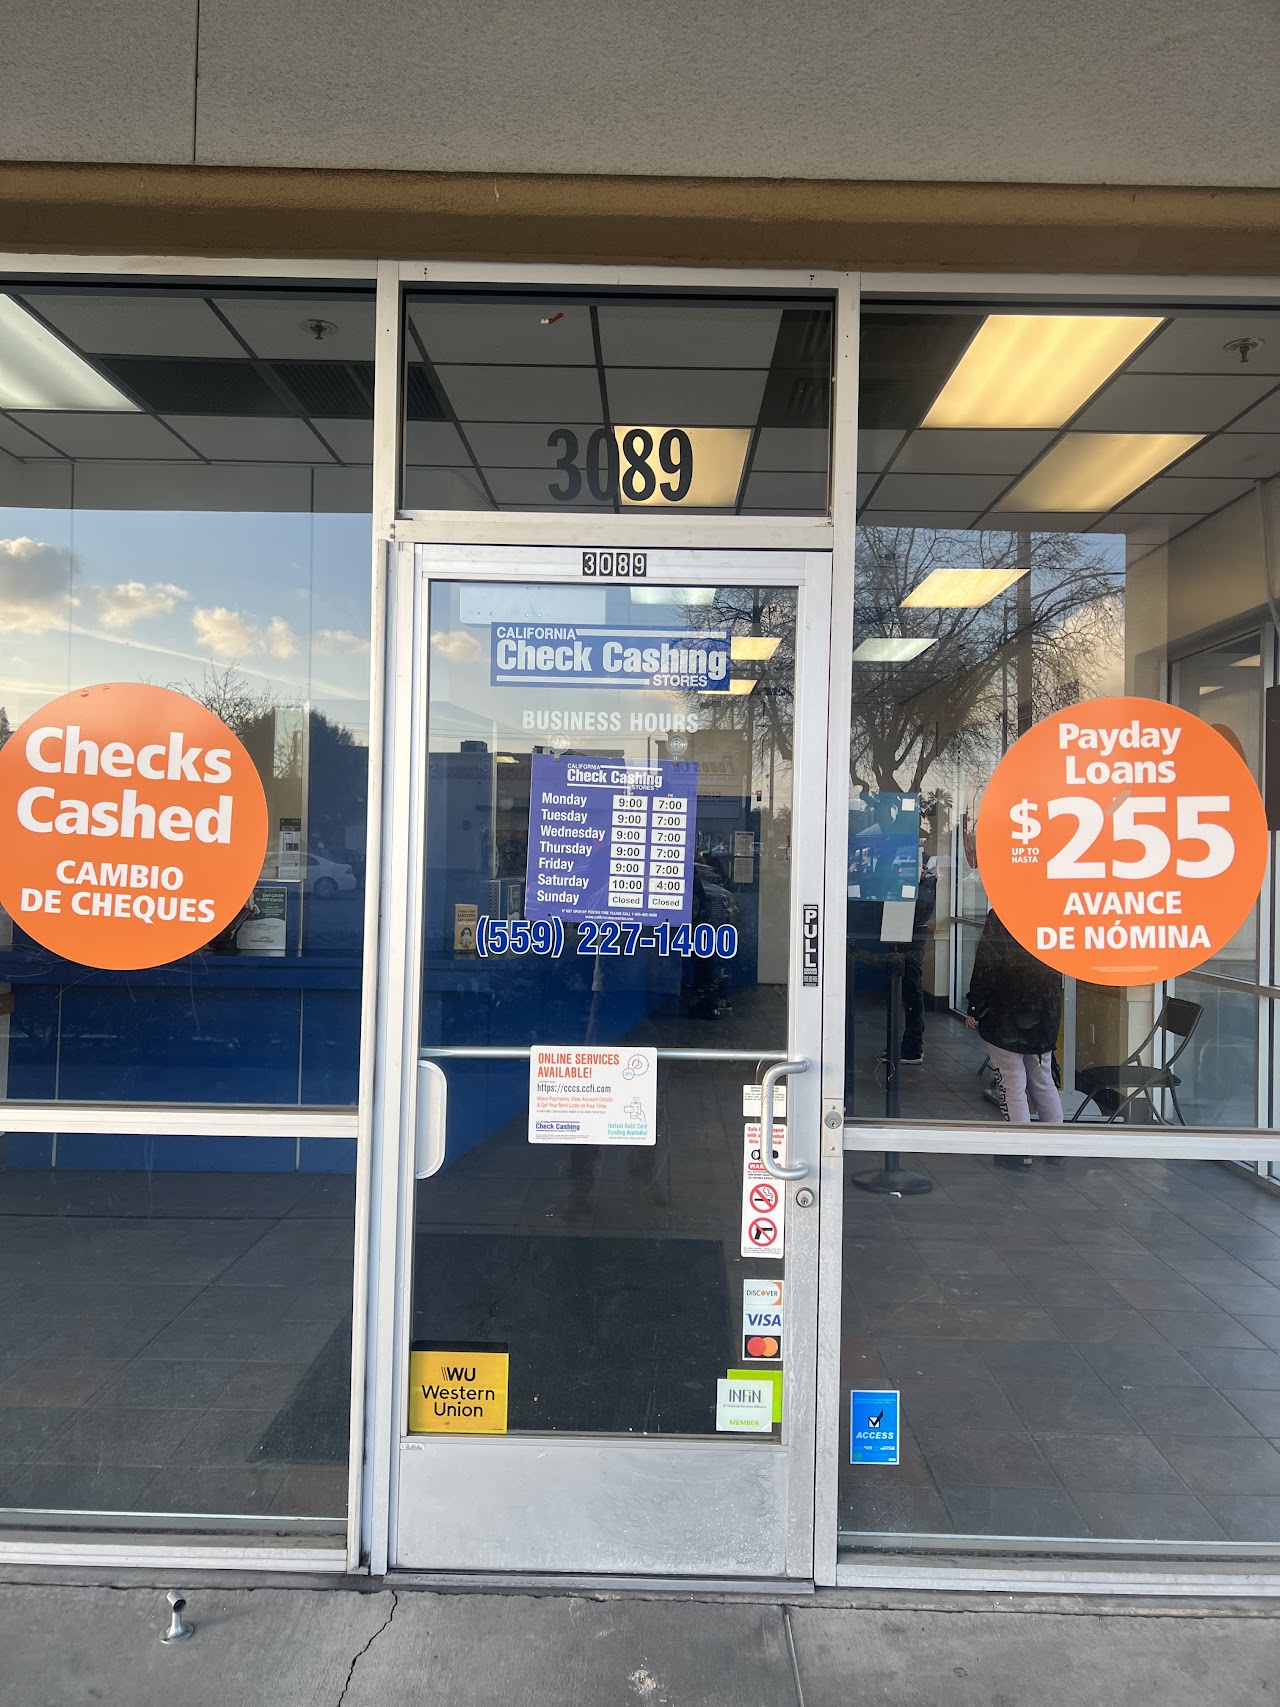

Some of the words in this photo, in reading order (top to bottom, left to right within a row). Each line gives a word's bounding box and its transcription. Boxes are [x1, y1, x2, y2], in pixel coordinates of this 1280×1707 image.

[547, 428, 693, 502] 3089
[583, 552, 646, 576] 3089
[496, 626, 576, 640] CALIFORNIA
[496, 639, 593, 672] Check
[602, 641, 727, 680] Cashing
[652, 674, 708, 687] STORES
[522, 710, 622, 732] BUSINESS
[630, 712, 699, 733] HOURS
[1058, 720, 1182, 756] Payday
[25, 725, 233, 784] Checks
[567, 768, 607, 783] Check
[610, 770, 663, 788] Cashing
[1065, 756, 1176, 785] Loans
[541, 792, 587, 807] Monday
[618, 798, 643, 808] 9:00
[658, 800, 682, 810] 7:00
[17, 786, 234, 844] Cashed
[541, 809, 588, 824] Tuesday
[617, 814, 641, 824] 9:00
[657, 816, 680, 826] 7:00
[540, 825, 605, 841] Wednesday
[616, 830, 640, 840] 9:00
[657, 832, 680, 842] 7:00
[539, 841, 592, 857] Thursday
[616, 847, 640, 857] 9:00
[656, 849, 680, 858] 7:00
[1011, 848, 1025, 856] UP
[1027, 848, 1040, 856] TO
[538, 857, 574, 872] Friday
[615, 863, 639, 873] 9:00
[655, 865, 679, 875] 7:00
[55, 860, 184, 891] CAMBIO
[537, 874, 589, 889] Saturday
[612, 879, 642, 889] 10:00
[656, 881, 680, 891] 4:00
[20, 888, 61, 914] DE
[71, 891, 216, 924] CHEQUES
[537, 890, 579, 906] Sunday
[612, 896, 640, 905] Closed
[652, 898, 680, 907] Closed
[1063, 891, 1182, 916] AVANCE
[475, 915, 564, 958] (559)
[577, 921, 738, 959] 227-1400
[804, 909, 818, 967] PULL
[1036, 926, 1075, 950] DE
[1084, 920, 1211, 950] NÓMINA
[538, 1053, 572, 1065] ONLINE
[575, 1053, 620, 1065] SERVICES
[537, 1066, 592, 1078] AVAILABLE!
[537, 1083, 611, 1094] https://cccs.ccfi.com
[556, 1123, 580, 1131] Cashing
[745, 1313, 782, 1327] VISA
[441, 1367, 476, 1381] WU
[421, 1385, 495, 1401] Western
[434, 1402, 483, 1417] Union
[856, 1431, 894, 1440] ACCESS
